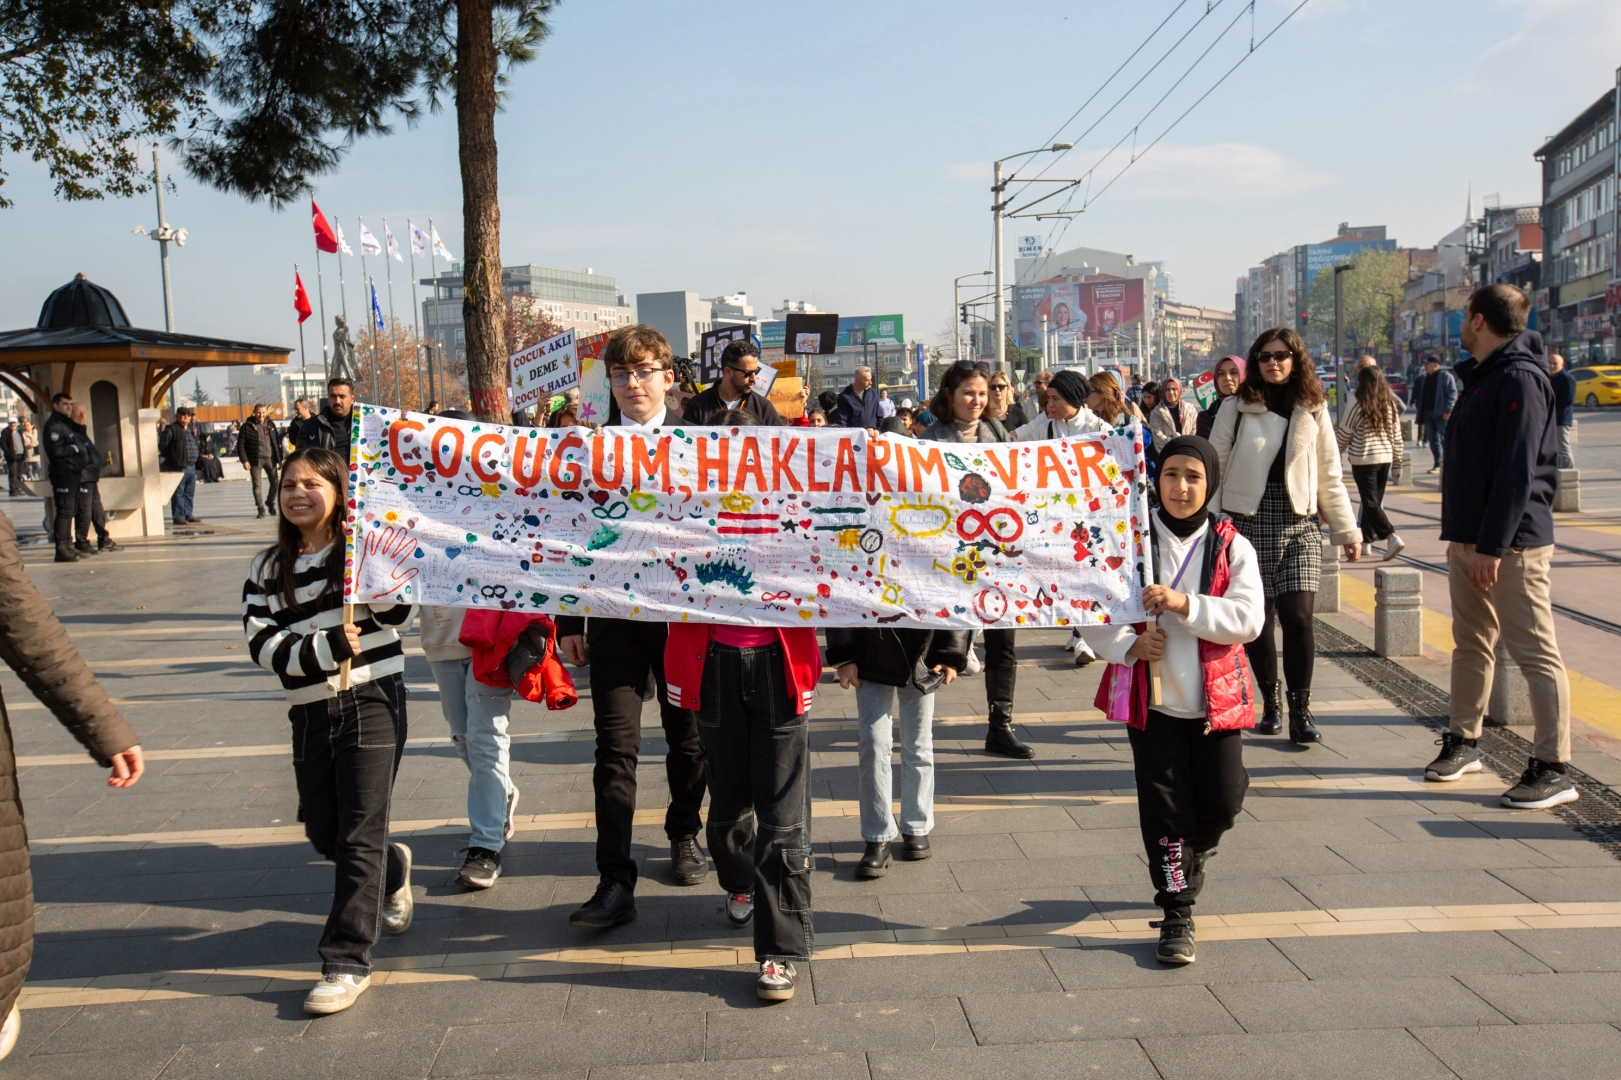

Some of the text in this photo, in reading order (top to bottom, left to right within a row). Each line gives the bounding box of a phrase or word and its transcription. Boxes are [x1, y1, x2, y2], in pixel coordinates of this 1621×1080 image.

[513, 334, 572, 371] ÇOCUK AKLI
[529, 359, 559, 381] DEME
[515, 385, 546, 408] ÇOCUK
[547, 372, 577, 392] HAKLI
[697, 436, 949, 493] HAKLARIM
[984, 440, 1123, 490] VAR
